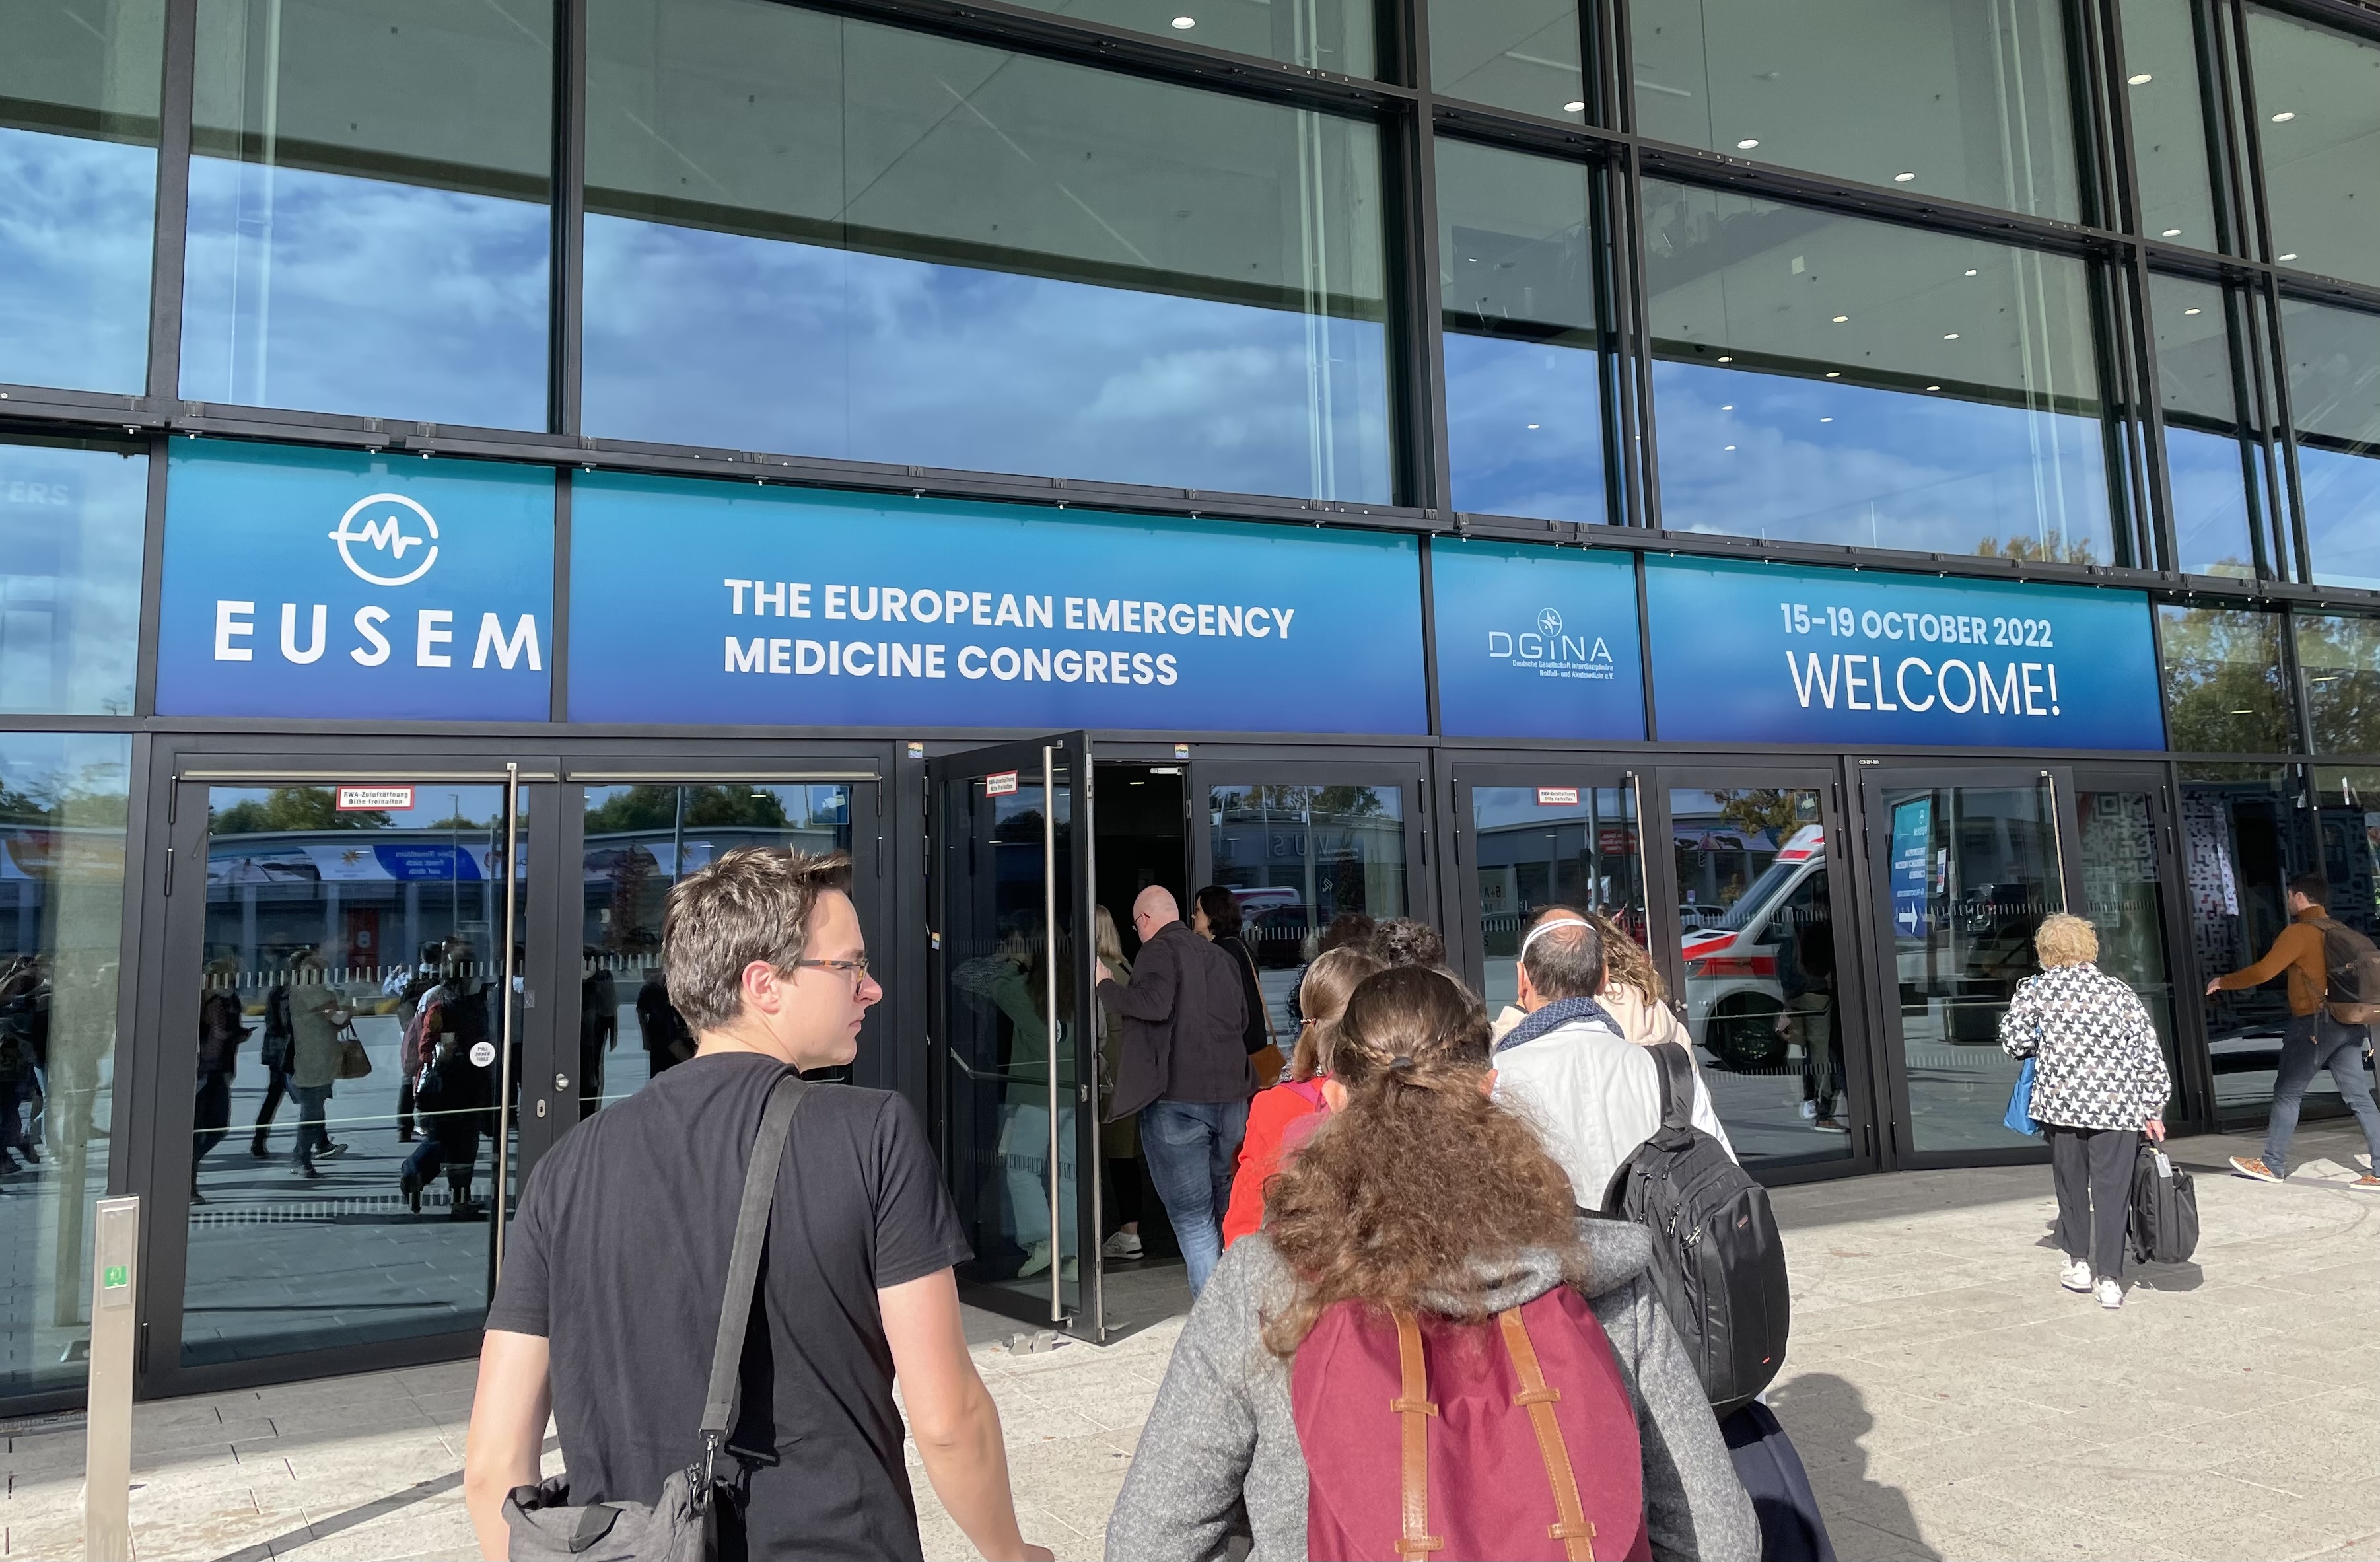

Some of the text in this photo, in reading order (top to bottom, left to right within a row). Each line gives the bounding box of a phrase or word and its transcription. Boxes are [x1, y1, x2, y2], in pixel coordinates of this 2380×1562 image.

[214, 600, 542, 671] EUSEM
[724, 579, 1295, 639] THE EUROPEAN EMERGENCY
[1861, 610, 1989, 645] OCTOBER
[1993, 617, 2054, 647] 2022
[724, 636, 1178, 686] MEDICINE CONGRESS
[1512, 659, 1537, 668] Deutsche
[1786, 651, 2060, 716] WELCOME!
